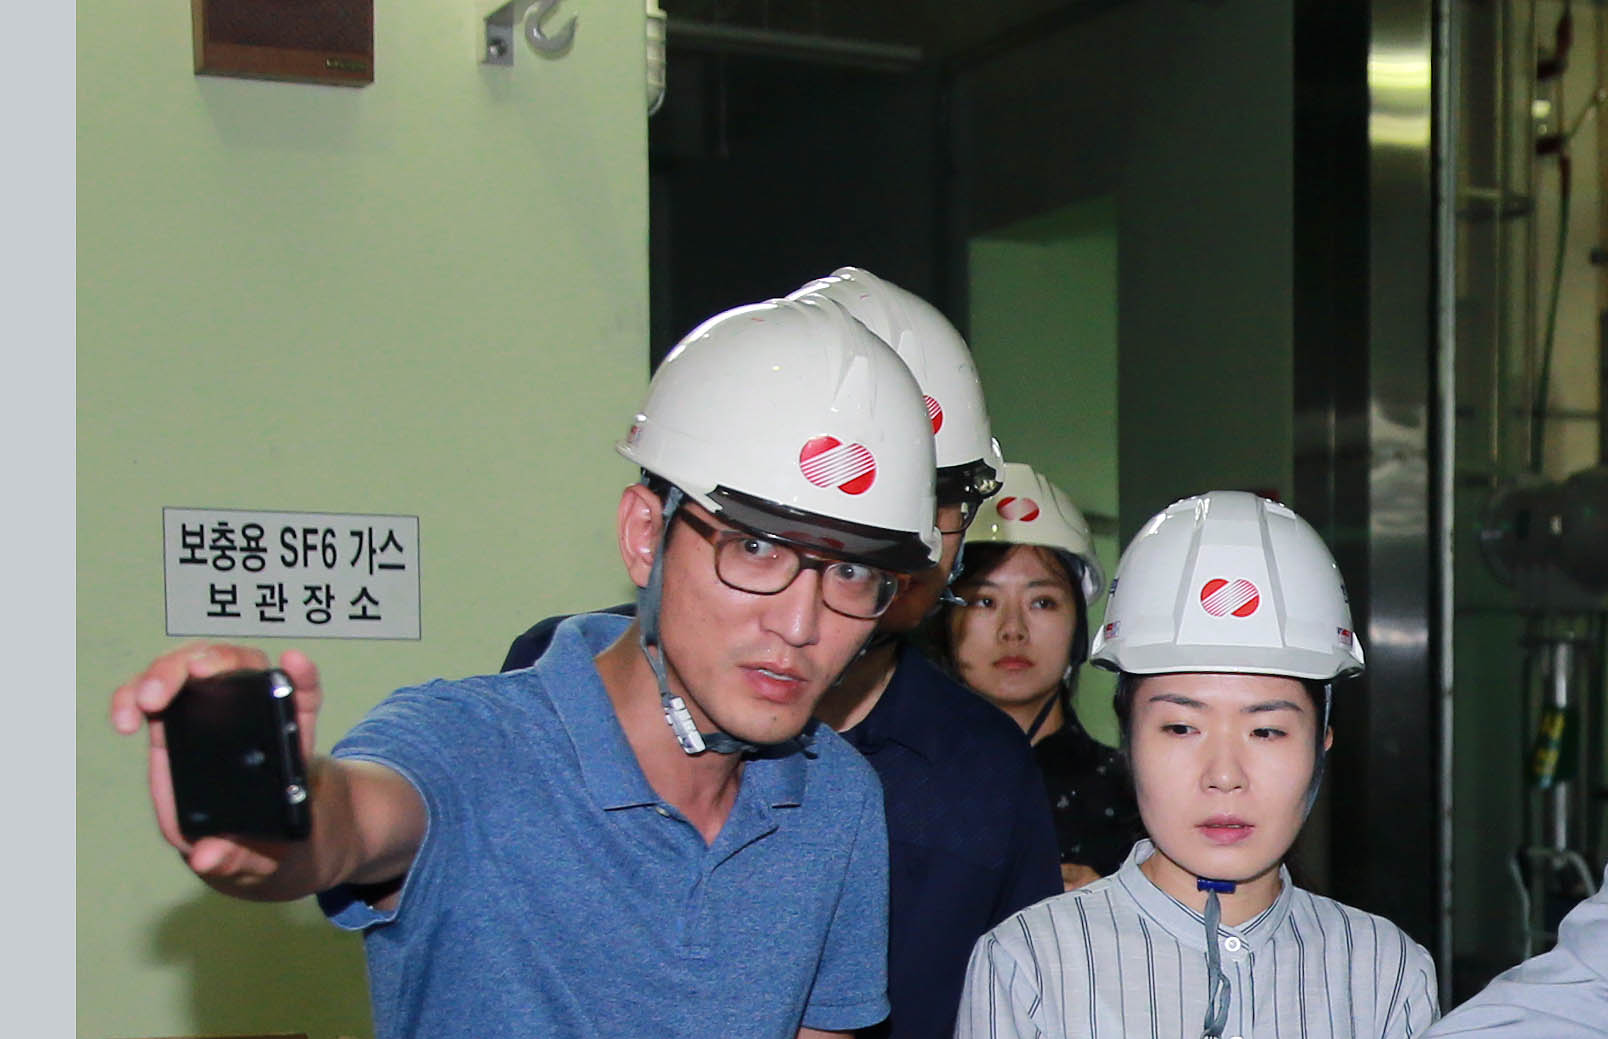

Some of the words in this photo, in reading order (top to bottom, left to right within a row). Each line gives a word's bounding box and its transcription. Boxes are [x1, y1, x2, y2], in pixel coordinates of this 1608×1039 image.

[179, 521, 268, 573] 보충용
[279, 526, 338, 569] SF6
[350, 526, 406, 576] 가스
